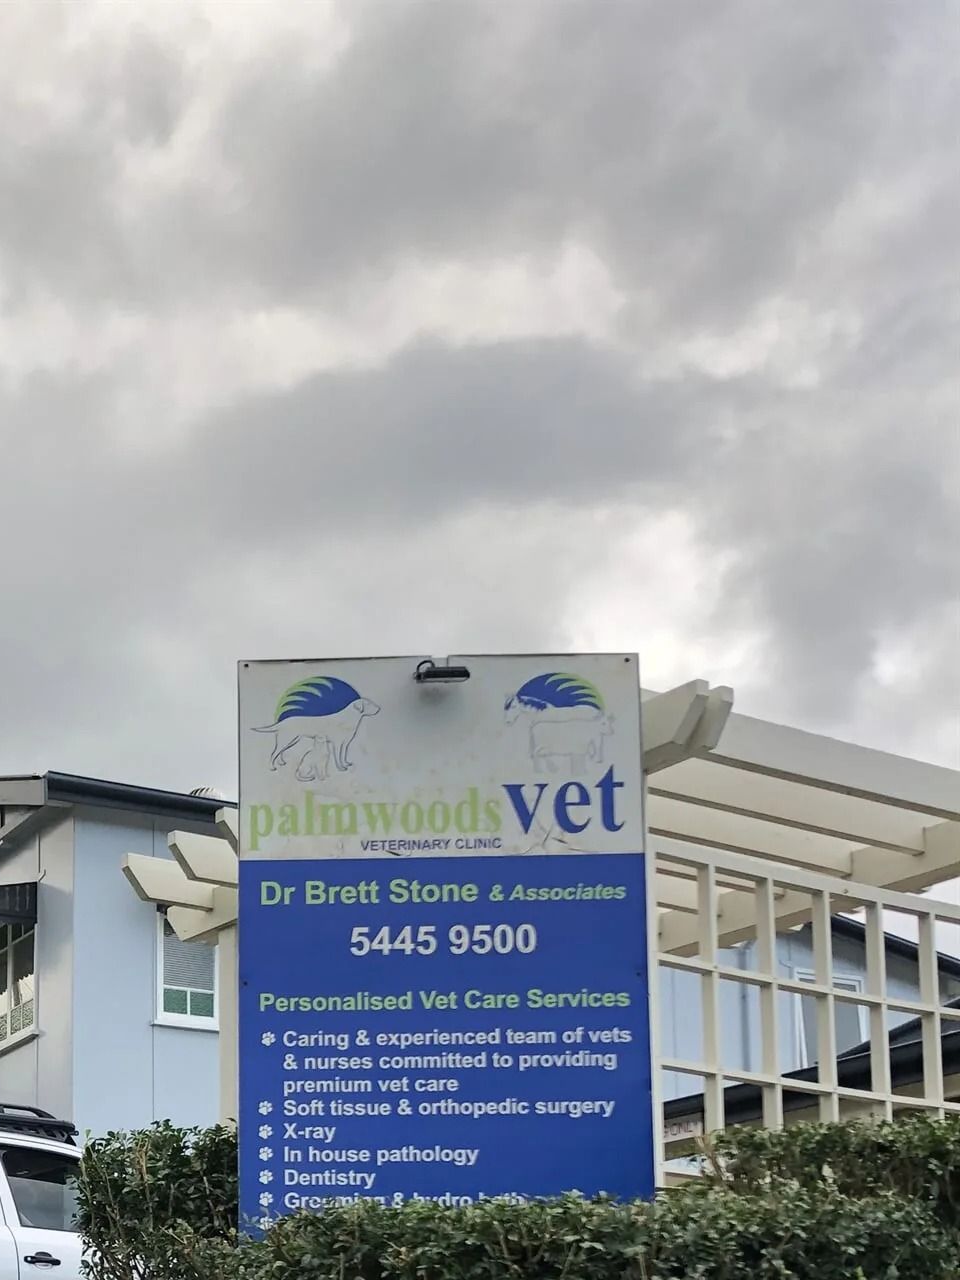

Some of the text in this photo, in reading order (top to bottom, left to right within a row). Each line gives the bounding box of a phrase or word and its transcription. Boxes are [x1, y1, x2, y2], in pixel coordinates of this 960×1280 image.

[248, 763, 626, 851] palmwoods vet
[360, 836, 502, 852] VETERINARY CLINIC
[260, 878, 626, 906] Dr Brett Stone & Associates
[350, 923, 537, 956] 5445 9500
[259, 988, 630, 1012] Personalised Vet Care Services
[282, 1026, 633, 1050] Caring & experienced team of vets
[282, 1050, 618, 1072] & nurses committed to providing
[283, 1076, 459, 1097] premium vet care
[283, 1097, 615, 1119] Soft tissue & orthopedic surgery
[283, 1122, 337, 1144] X-ray
[284, 1145, 480, 1166] In house pathology
[284, 1168, 377, 1190] Dentistry
[391, 1191, 404, 1209] &
[413, 1191, 473, 1207] hdro
[478, 1191, 526, 1206] th
